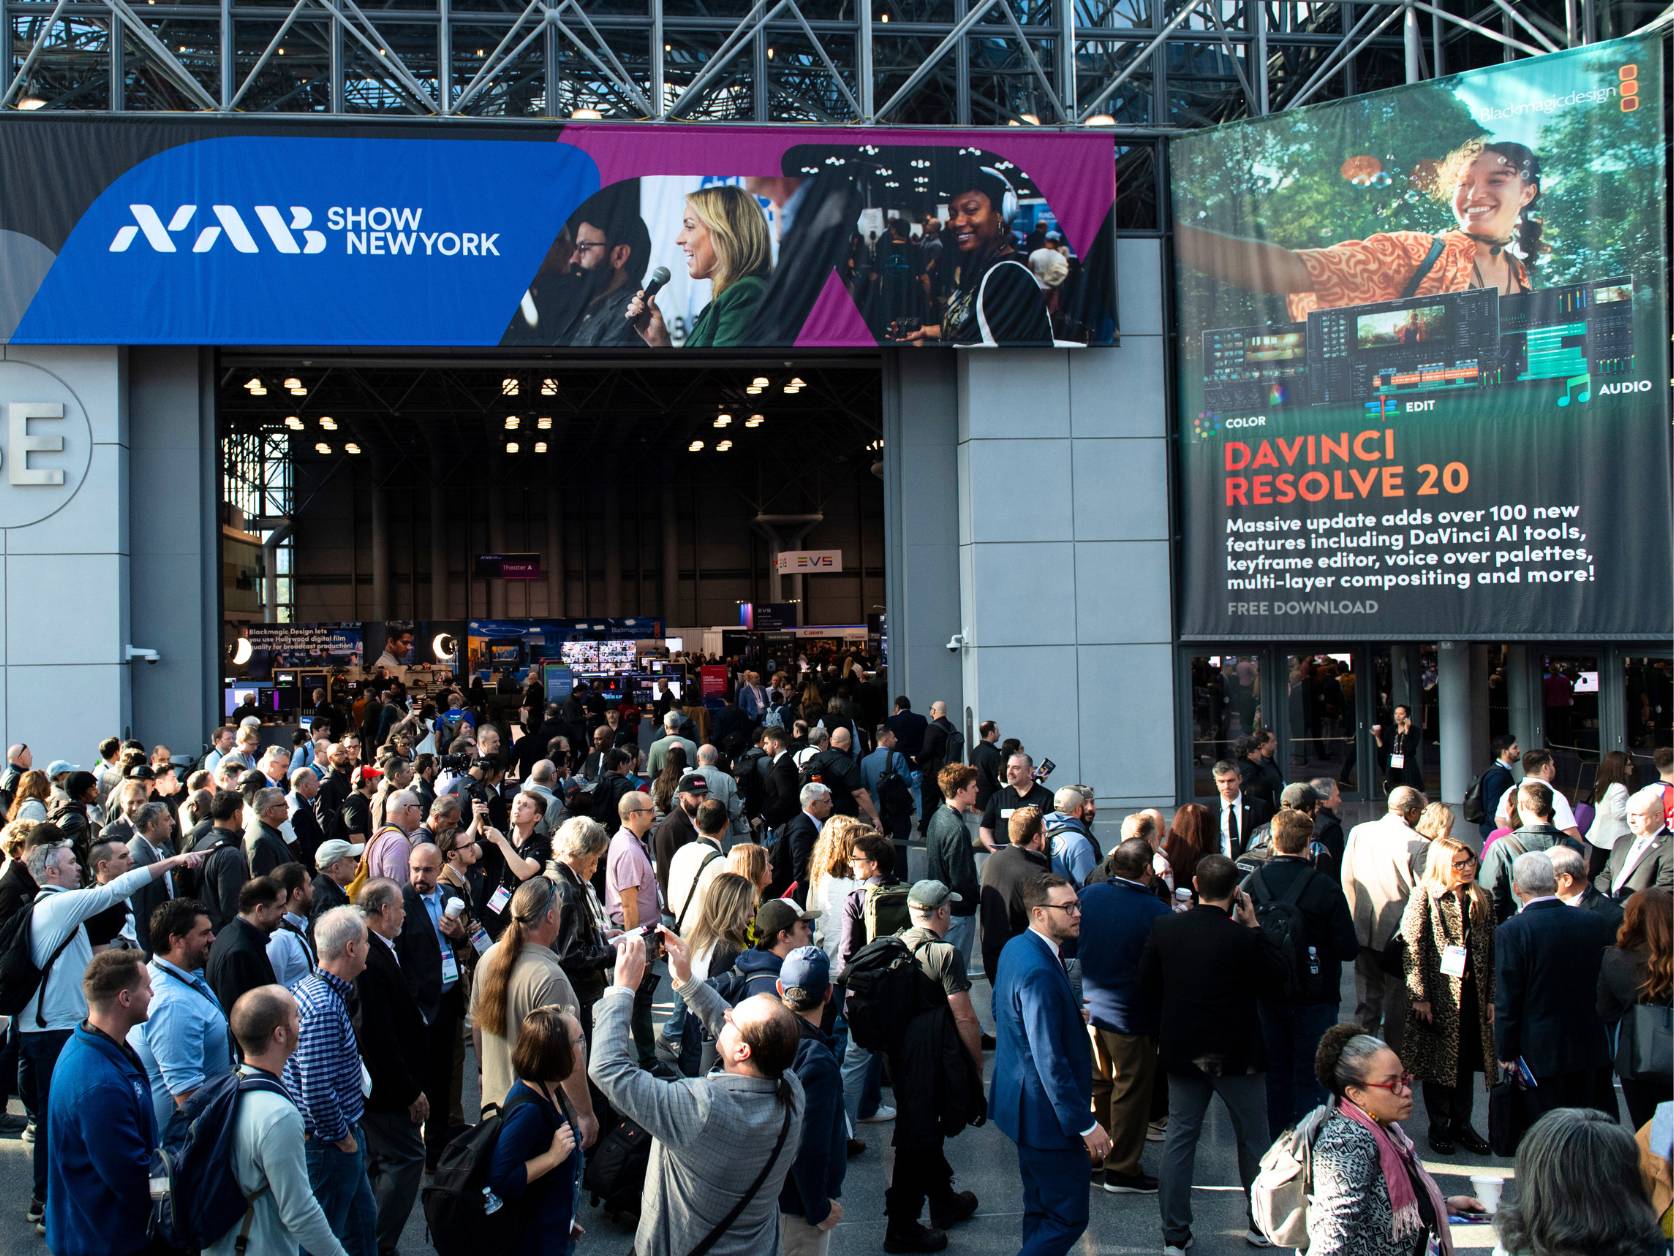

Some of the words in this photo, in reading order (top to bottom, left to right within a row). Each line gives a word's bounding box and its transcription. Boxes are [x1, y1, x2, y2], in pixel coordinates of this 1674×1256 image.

[1479, 86, 1617, 122] Blackmagicdesign
[109, 204, 327, 254] NAB
[327, 206, 423, 231] SHOW
[1599, 380, 1653, 396] AUDIO
[1406, 399, 1436, 413] EDIT
[1225, 415, 1267, 430] COLOR
[1225, 429, 1395, 471] DAVINCI
[1226, 465, 1405, 506] RESOLVE
[1417, 461, 1469, 496] 20
[1226, 515, 1302, 534] Massive
[1306, 512, 1377, 534] update
[1381, 508, 1433, 526] adds
[1437, 509, 1486, 524] over
[1489, 504, 1527, 522] 100
[1533, 505, 1580, 519] new
[1226, 534, 1306, 553] features
[1310, 530, 1404, 550] including
[1410, 526, 1490, 545] DaVinci
[1495, 524, 1518, 542] AI
[1523, 522, 1587, 542] tools,
[797, 556, 833, 567] EVS
[1226, 554, 1314, 574] keyframe
[1317, 551, 1381, 569] editor,
[1384, 549, 1439, 567] voice
[1443, 550, 1491, 565] over
[1495, 545, 1594, 567] palettes,
[1227, 572, 1336, 593] multi-layer
[1340, 568, 1471, 590] compositing
[1477, 566, 1521, 585] and
[1527, 564, 1596, 583] more!
[1227, 601, 1270, 616] FREE
[1273, 599, 1379, 616] DOWNLOAD
[249, 628, 289, 636] Blackmagic
[290, 628, 314, 636] Design
[275, 636, 309, 644] Hollywood
[310, 635, 332, 643] digital
